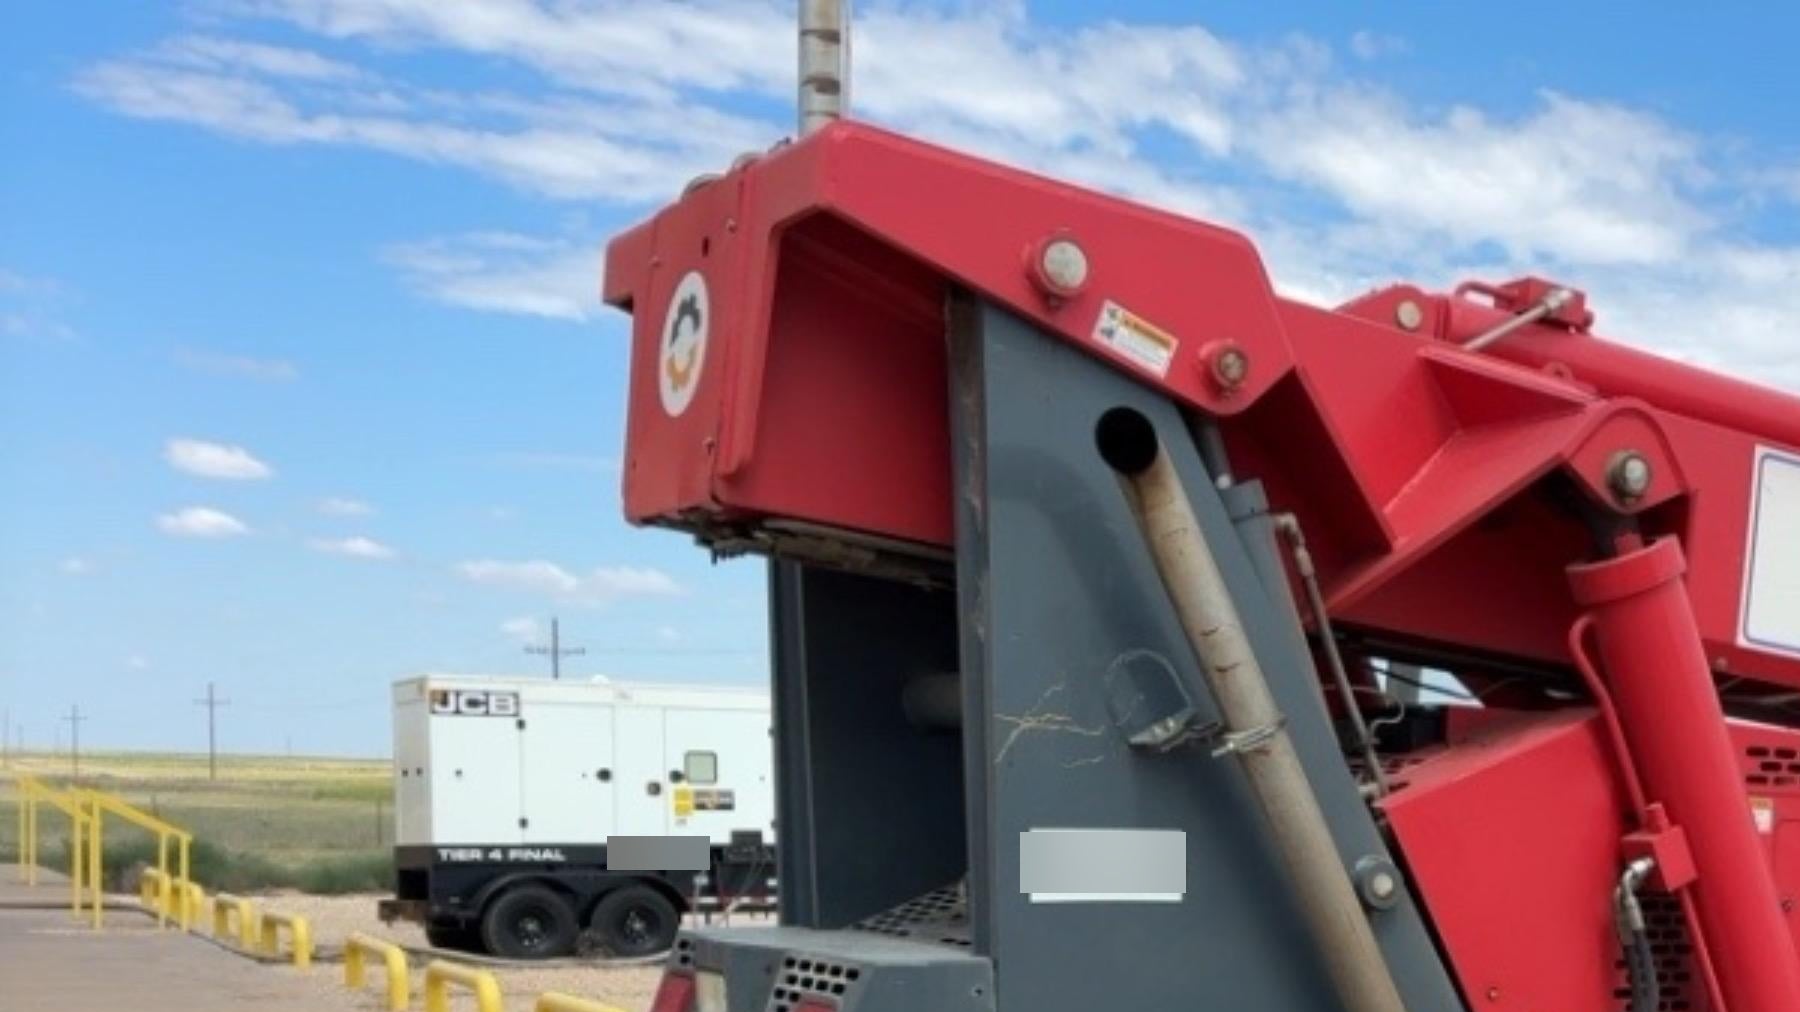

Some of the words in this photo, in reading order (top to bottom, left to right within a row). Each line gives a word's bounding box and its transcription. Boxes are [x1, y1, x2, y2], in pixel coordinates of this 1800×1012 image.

[431, 689, 519, 716] JCB
[437, 848, 484, 862] TIER
[488, 848, 503, 862] 4
[508, 848, 566, 862] FINAL
